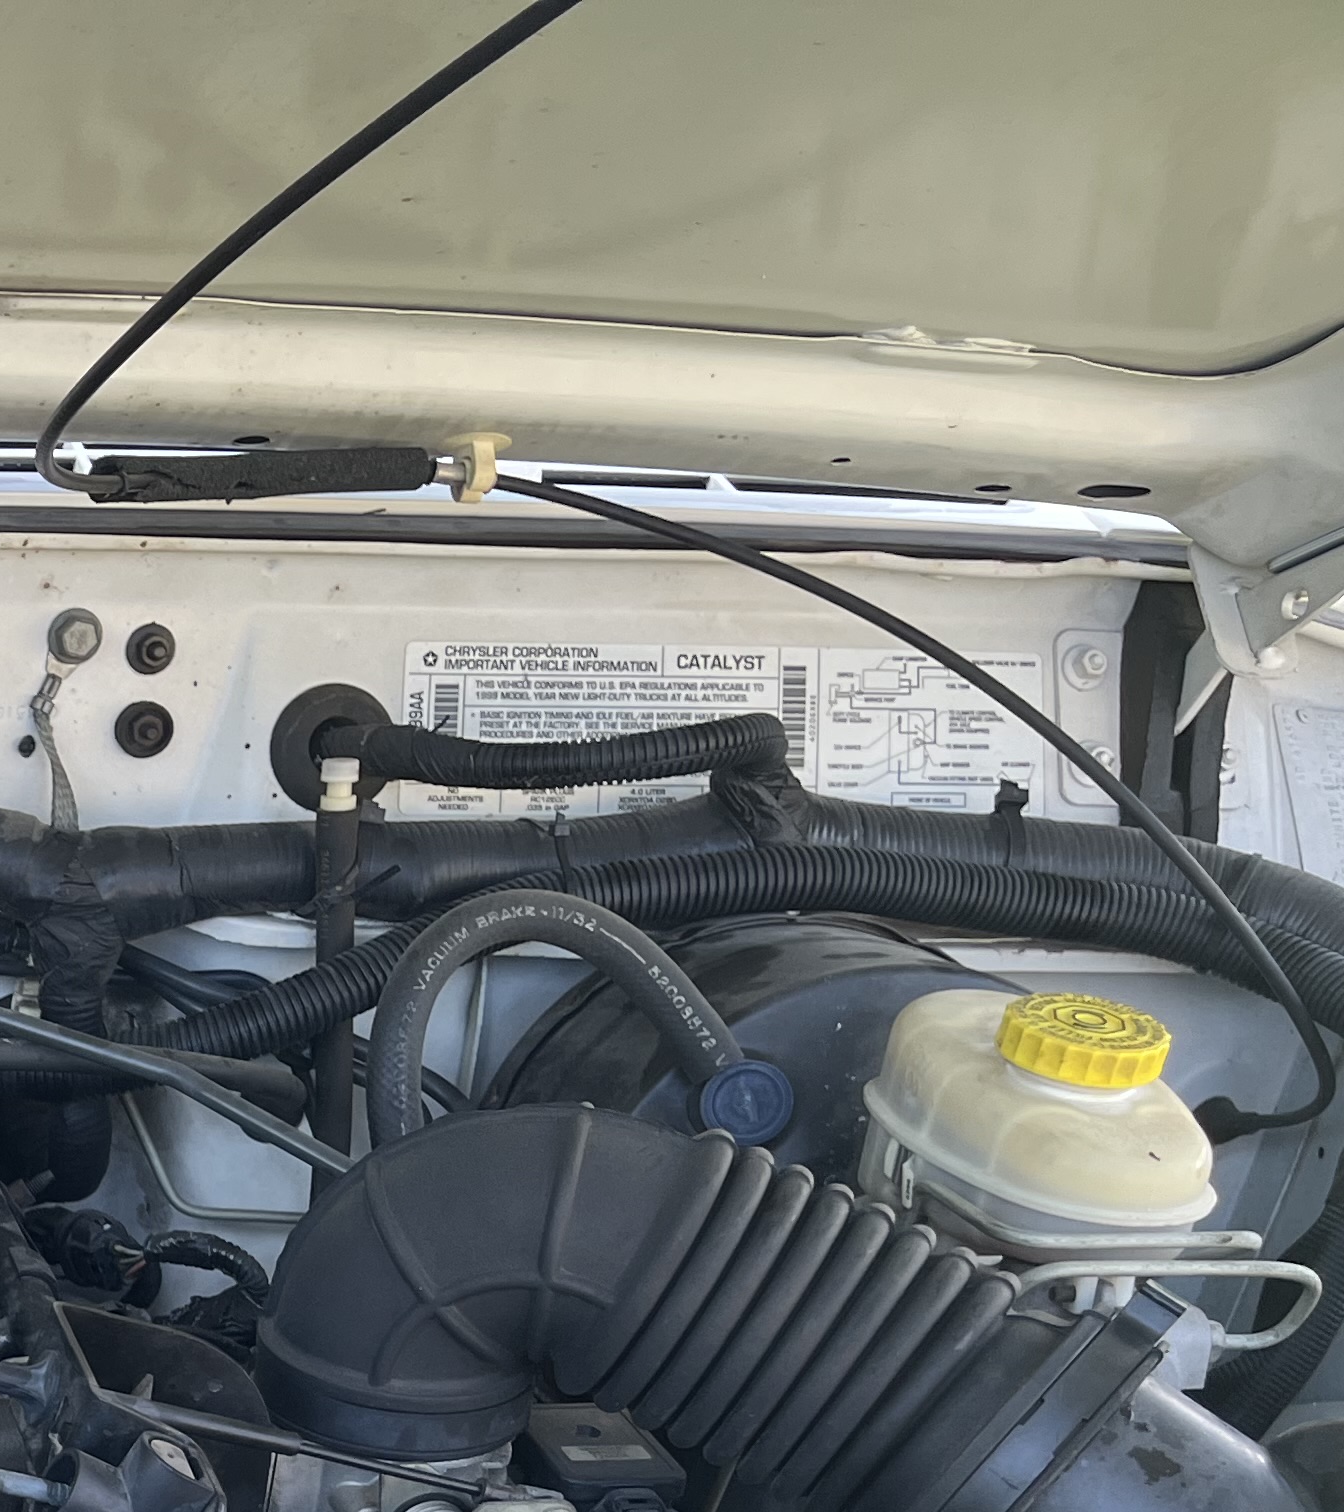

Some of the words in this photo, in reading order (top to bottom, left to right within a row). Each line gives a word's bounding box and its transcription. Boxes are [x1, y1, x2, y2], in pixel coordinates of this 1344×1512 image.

[445, 645, 508, 658] CHRYSLER
[513, 645, 598, 659] CORPORATION
[444, 659, 515, 671] IMPORTANT
[520, 659, 568, 672] VEHICLE
[573, 660, 658, 673] INFORMATION
[677, 654, 765, 671] CATALYST
[476, 679, 494, 690] THIS
[497, 679, 531, 690] VEHICLE
[534, 680, 583, 690] CONFORMS
[586, 681, 598, 690] TO
[619, 681, 636, 691] EPA
[639, 682, 698, 692] REGULATIONS
[700, 682, 750, 693] APPLICABLE
[753, 683, 765, 693] TO
[501, 691, 531, 701] MODEL
[533, 692, 556, 701] YEAR
[559, 692, 579, 702] NEW
[582, 692, 631, 702] LIGHT-DUTY
[634, 692, 668, 702] TRUCKS
[670, 693, 682, 703] AT
[684, 693, 699, 703] ALL
[479, 711, 504, 720] BASIC
[506, 711, 542, 720] IGNITION
[574, 711, 594, 720] AND
[479, 721, 509, 730] PRESET
[513, 721, 524, 730] AT
[413, 926, 470, 992] VACUUM
[474, 905, 537, 931] BRAKE
